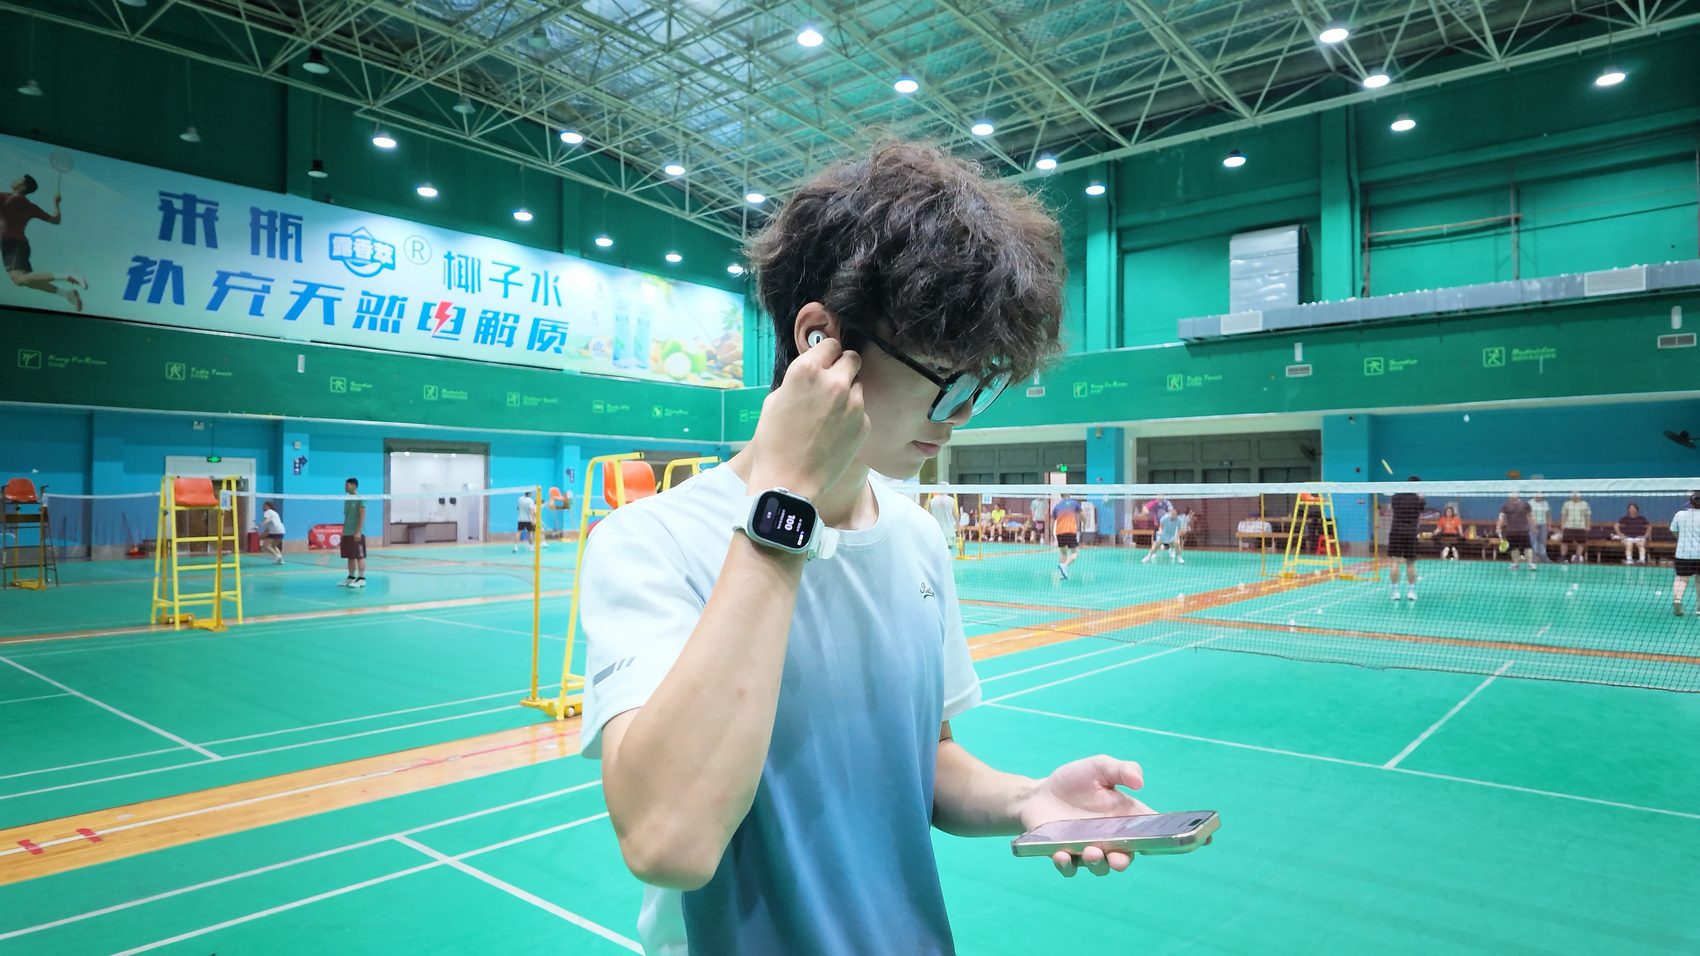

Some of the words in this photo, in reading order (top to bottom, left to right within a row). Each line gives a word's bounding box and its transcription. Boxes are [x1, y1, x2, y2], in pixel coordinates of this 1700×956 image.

[157, 190, 304, 263] 来瓶
[442, 250, 564, 308] 椰子水
[123, 255, 570, 355] 补充天然电解质
[784, 514, 796, 531] 100
